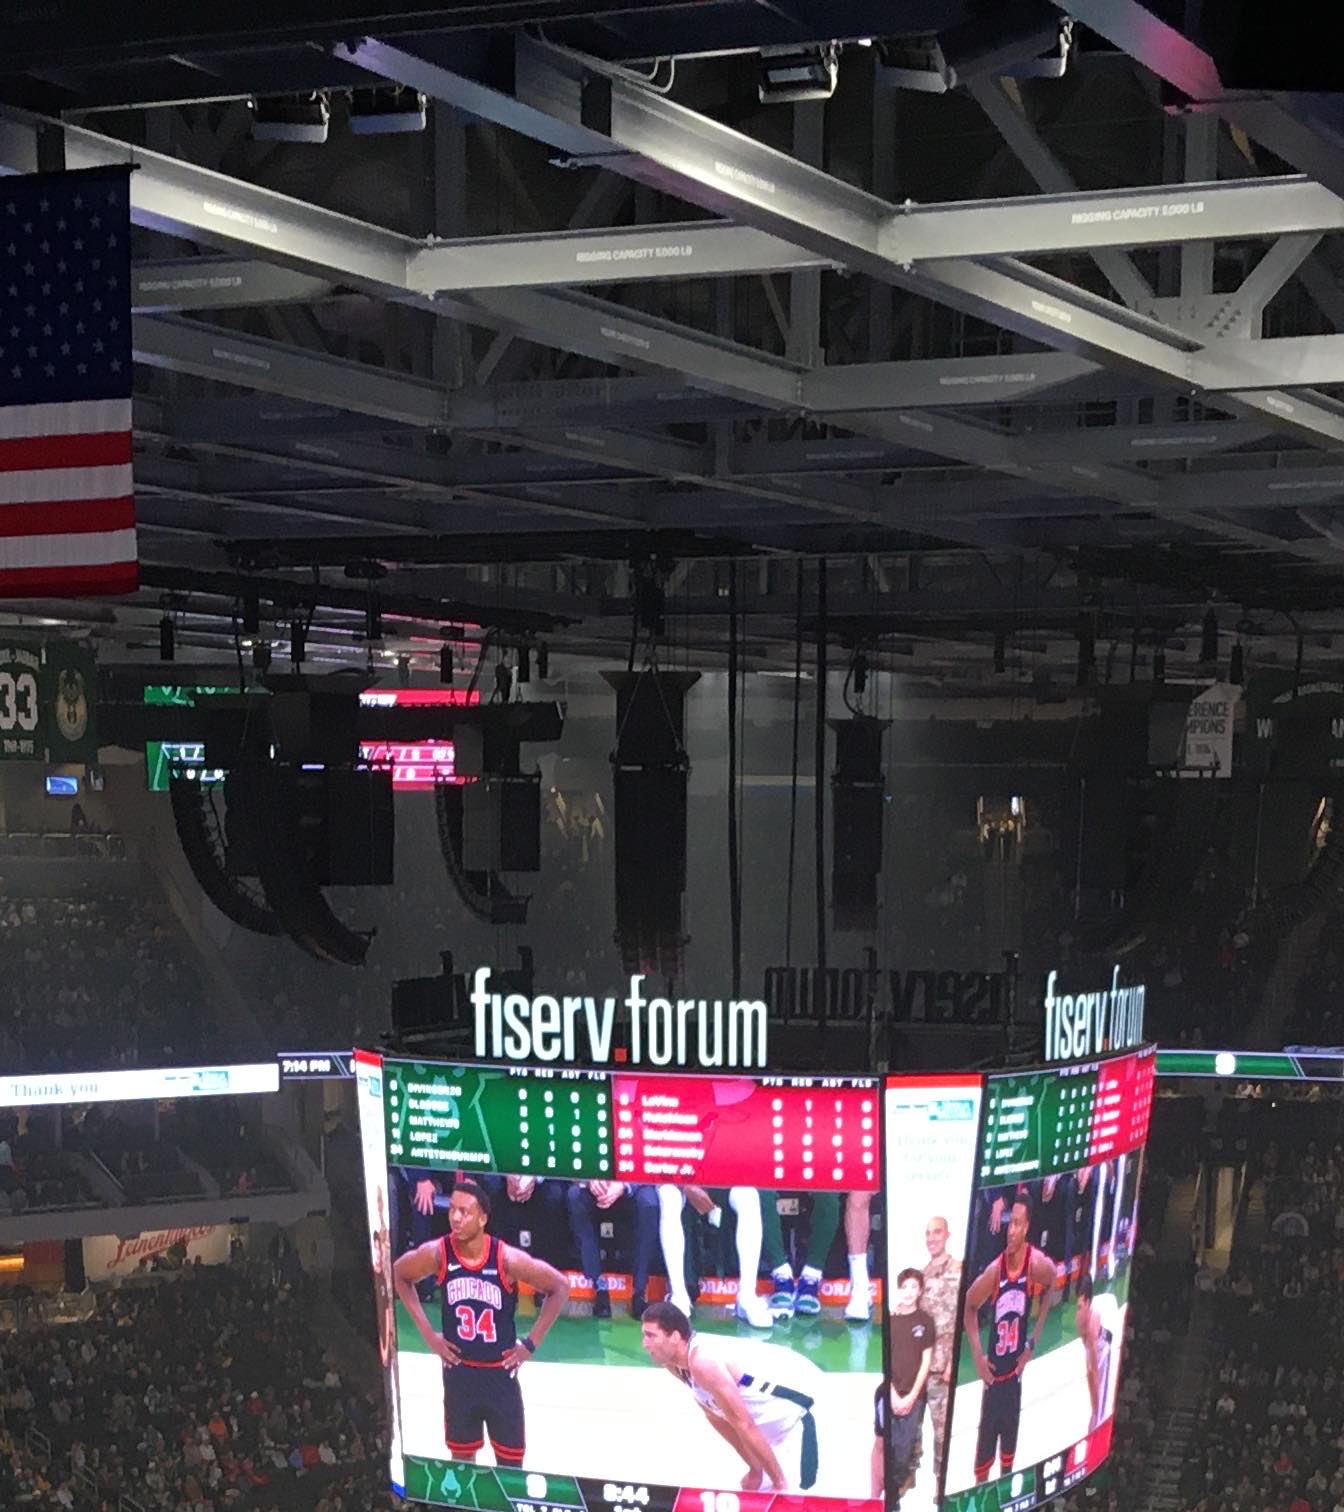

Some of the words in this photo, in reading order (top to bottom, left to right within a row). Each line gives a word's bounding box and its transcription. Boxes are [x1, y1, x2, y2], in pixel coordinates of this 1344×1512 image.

[1113, 206, 1160, 221] CAPACITY
[613, 247, 654, 260] CAPACITY
[574, 1109, 579, 1120] 1
[549, 1124, 554, 1135] 1
[550, 1140, 555, 1151] 1
[866, 1169, 873, 1180] 1
[446, 1277, 502, 1310] CHICAGO
[456, 1305, 497, 1342] 34
[996, 1317, 1020, 1356] 34
[604, 1483, 650, 1506] 8:44
